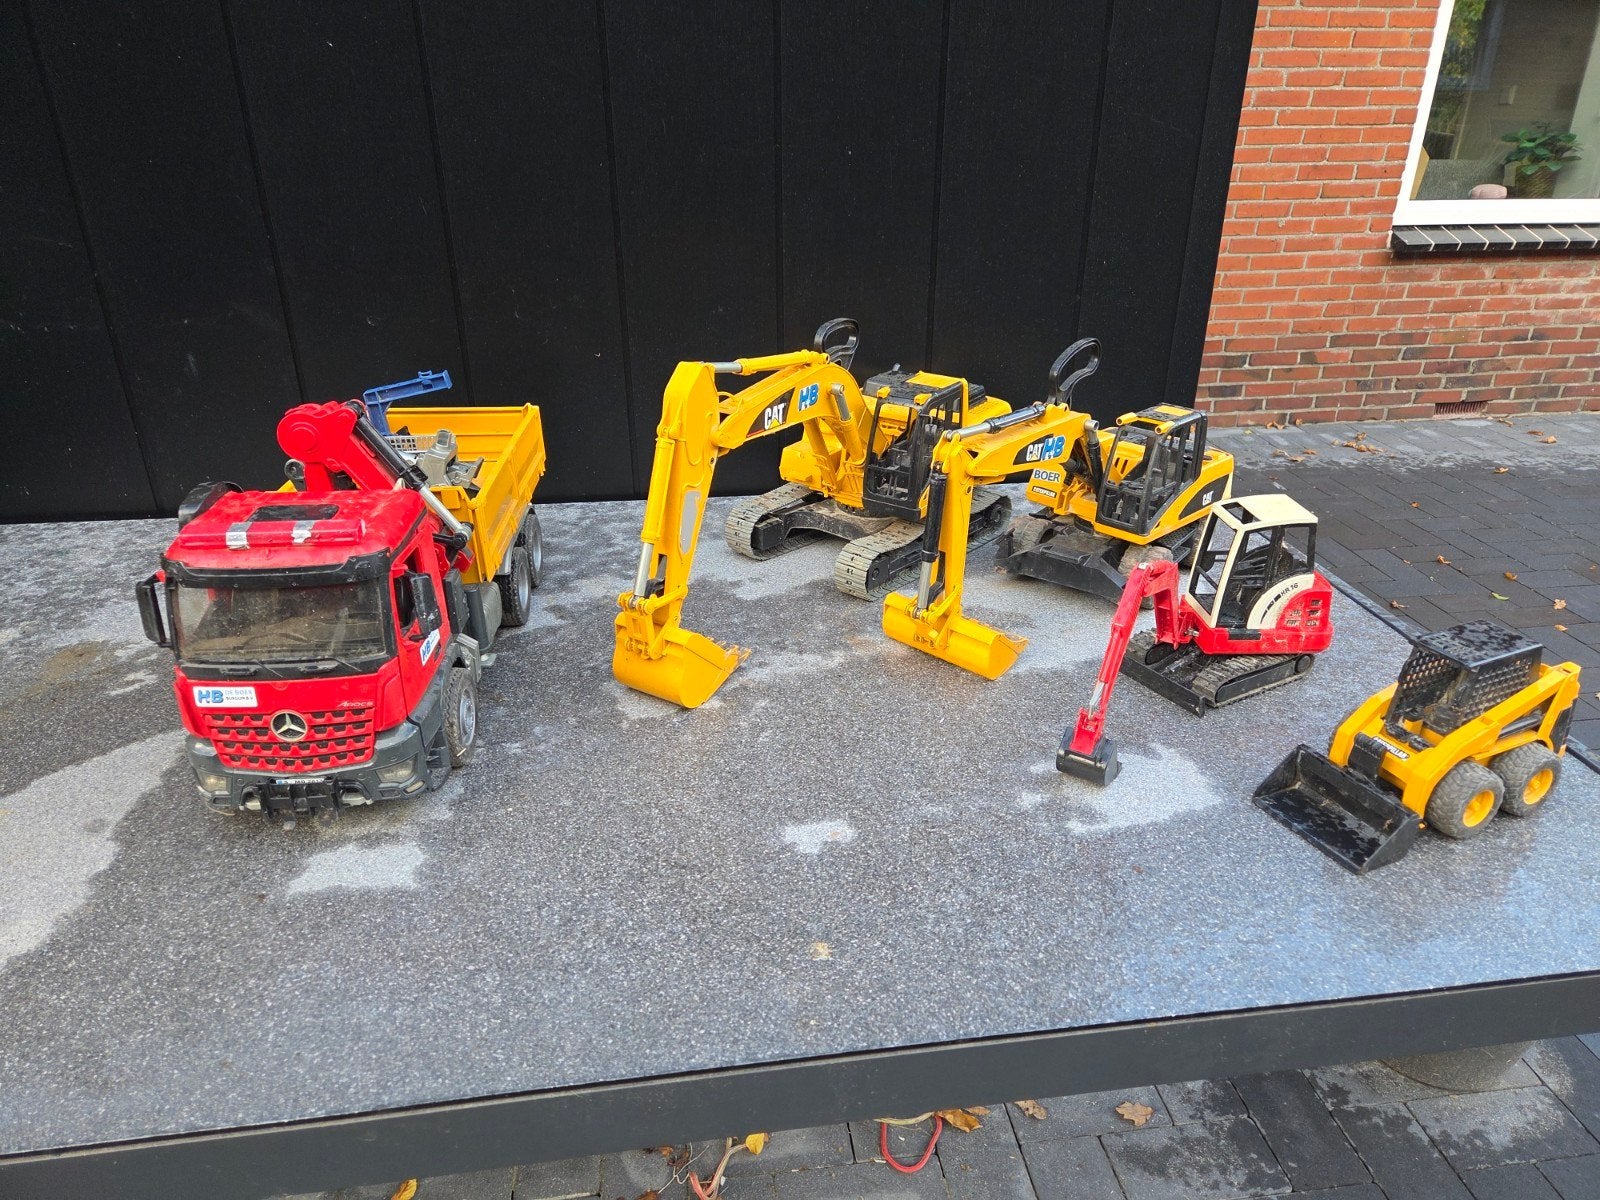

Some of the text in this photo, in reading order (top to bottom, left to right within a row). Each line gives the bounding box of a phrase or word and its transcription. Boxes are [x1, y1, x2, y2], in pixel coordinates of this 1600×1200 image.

[798, 383, 819, 411] HB
[764, 402, 786, 430] CAT
[1026, 435, 1065, 461] CAT HB
[1034, 469, 1060, 482] BOER
[198, 689, 224, 704] HB
